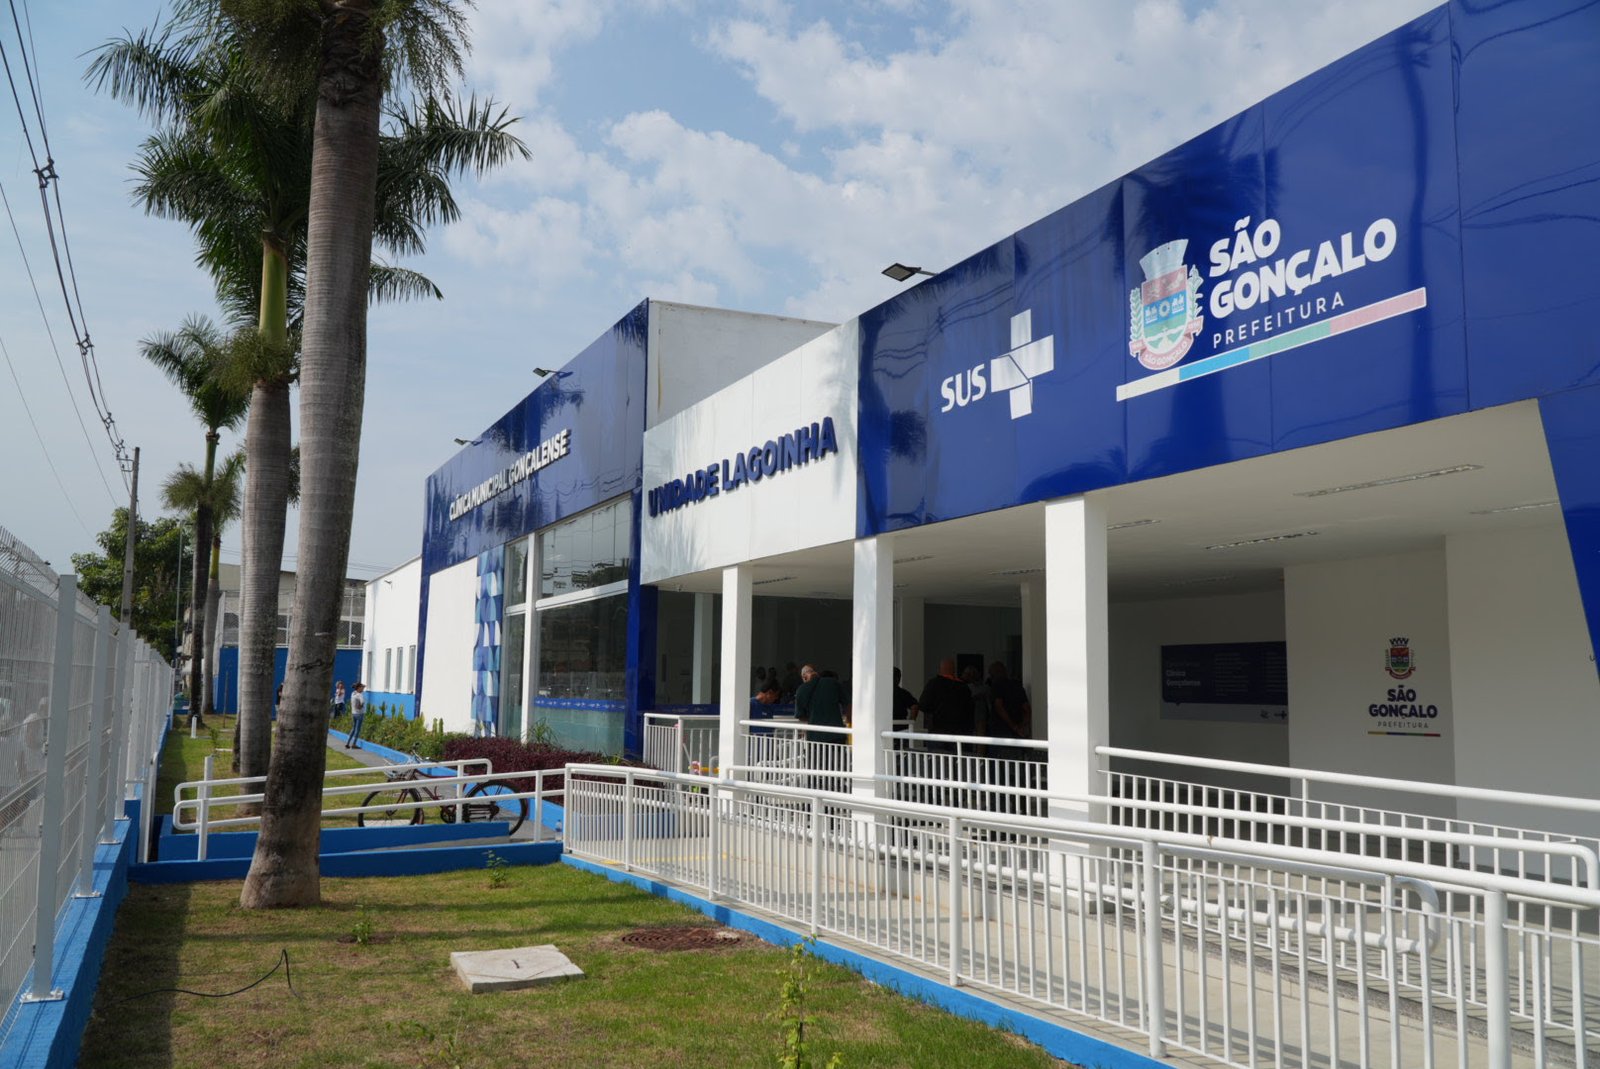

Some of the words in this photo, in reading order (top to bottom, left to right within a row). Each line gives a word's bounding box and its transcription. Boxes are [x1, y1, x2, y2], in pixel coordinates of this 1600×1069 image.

[1209, 216, 1281, 277] SÃO
[1210, 218, 1397, 319] GONÇALO
[1213, 291, 1345, 349] PREFEITURA
[941, 363, 987, 413] SUS
[471, 468, 508, 508] MUNICIPAL
[508, 429, 570, 487] GONÇALENSE
[648, 462, 720, 518] UNIDADE
[722, 416, 838, 491] LAGOINHA
[1368, 703, 1438, 719] GONÇALO
[1387, 684, 1417, 702] SÃO
[1377, 721, 1429, 729] PREFEITURA
